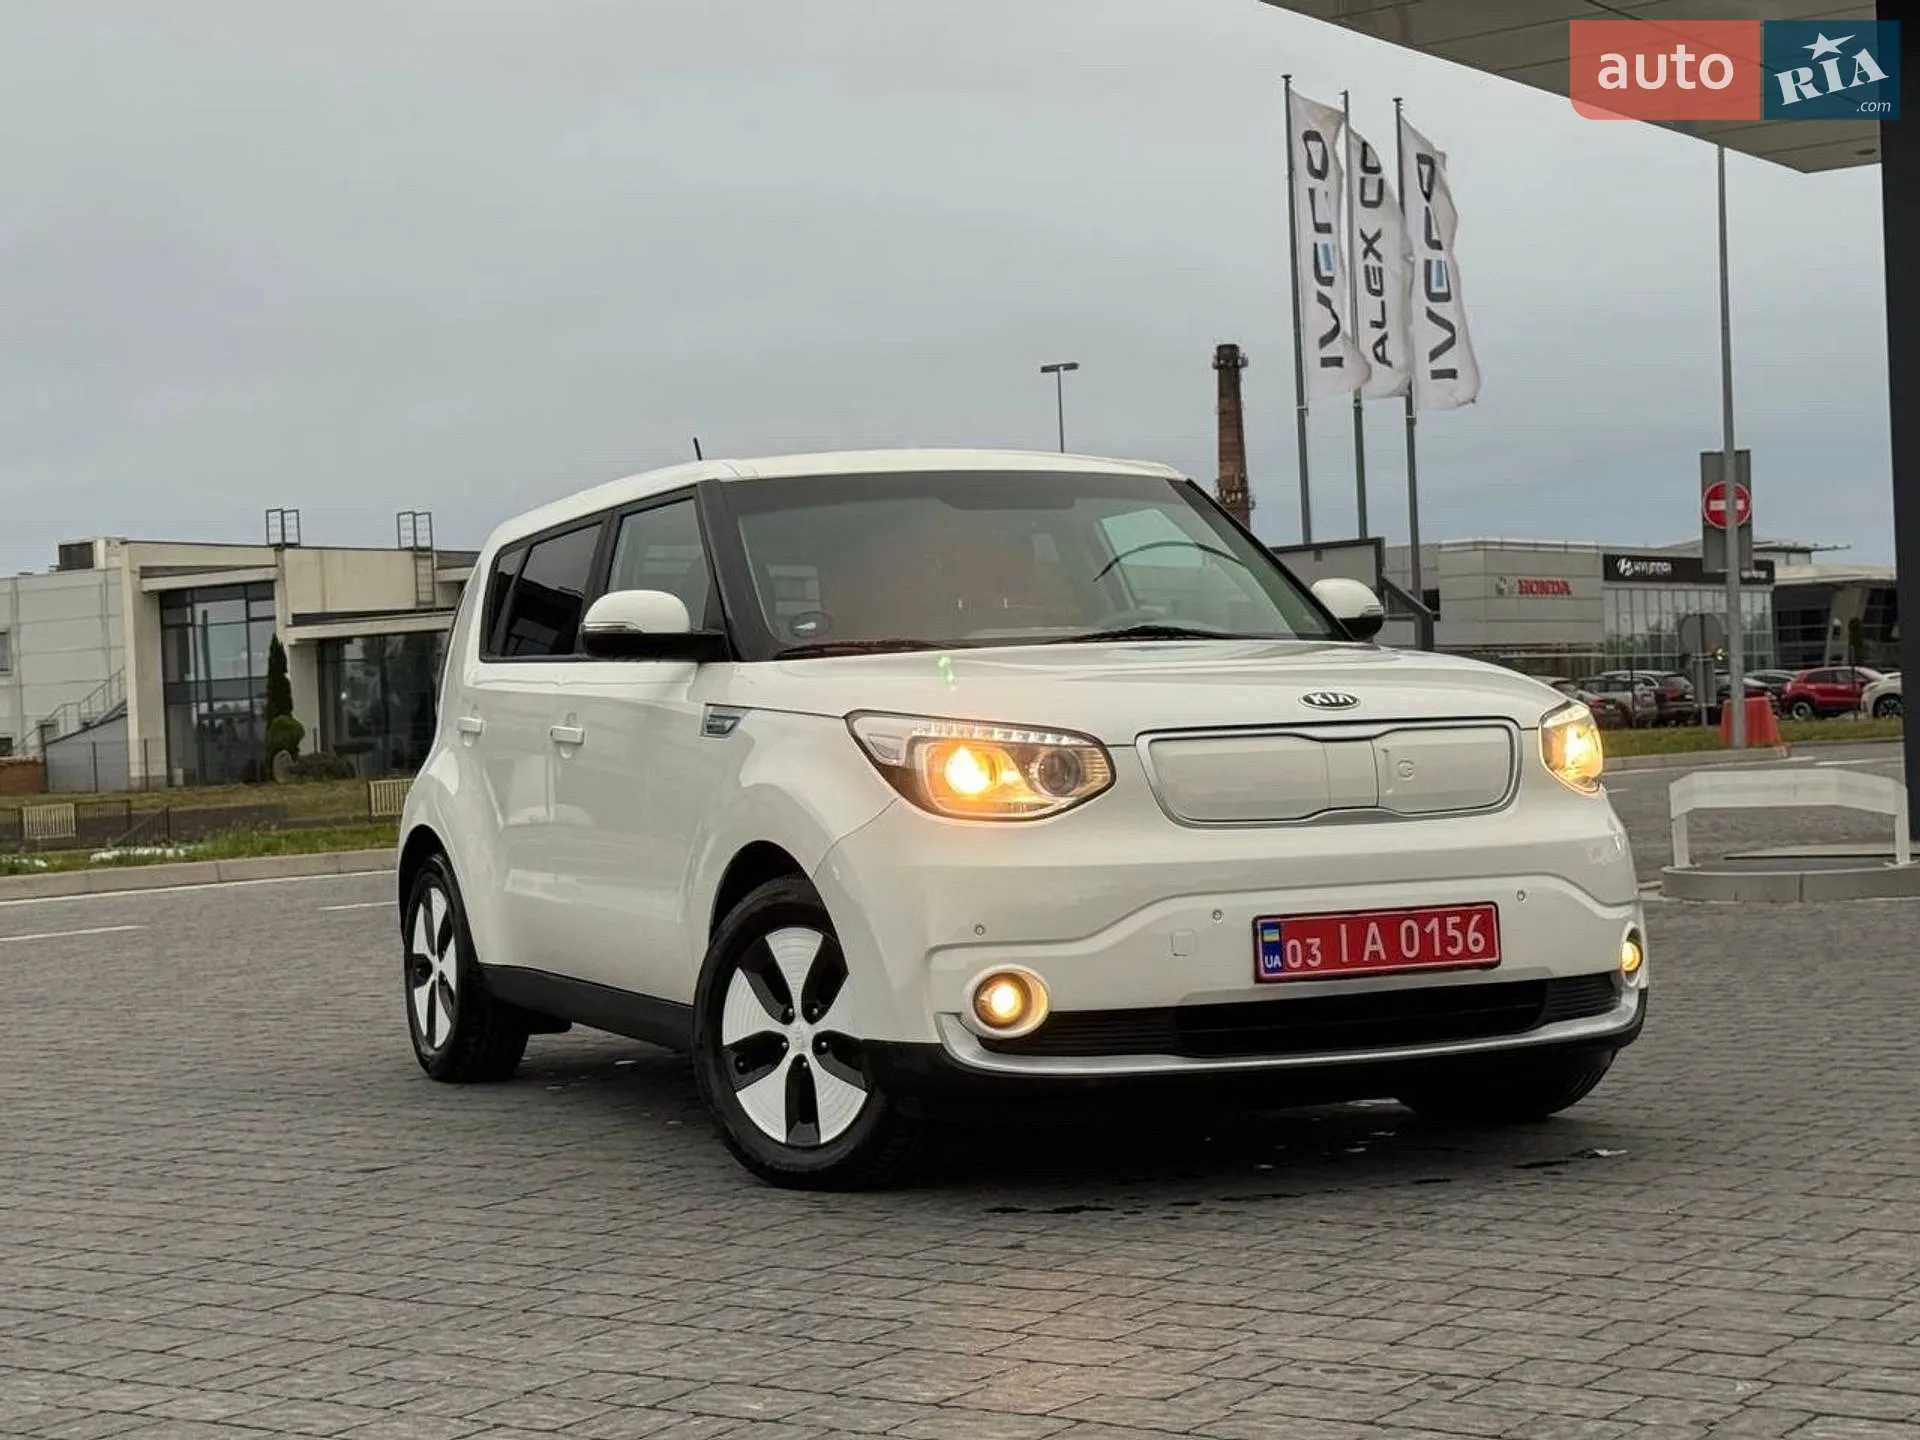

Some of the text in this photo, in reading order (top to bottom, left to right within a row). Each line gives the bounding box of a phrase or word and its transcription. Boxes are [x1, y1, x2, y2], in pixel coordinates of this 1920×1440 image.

[1359, 228, 1393, 369] ALEX
[1517, 578, 1572, 596] HONDA
[1306, 692, 1355, 706] KIA
[1286, 937, 1322, 969] 03
[1400, 914, 1486, 959] 0156
[1264, 955, 1282, 969] UA
